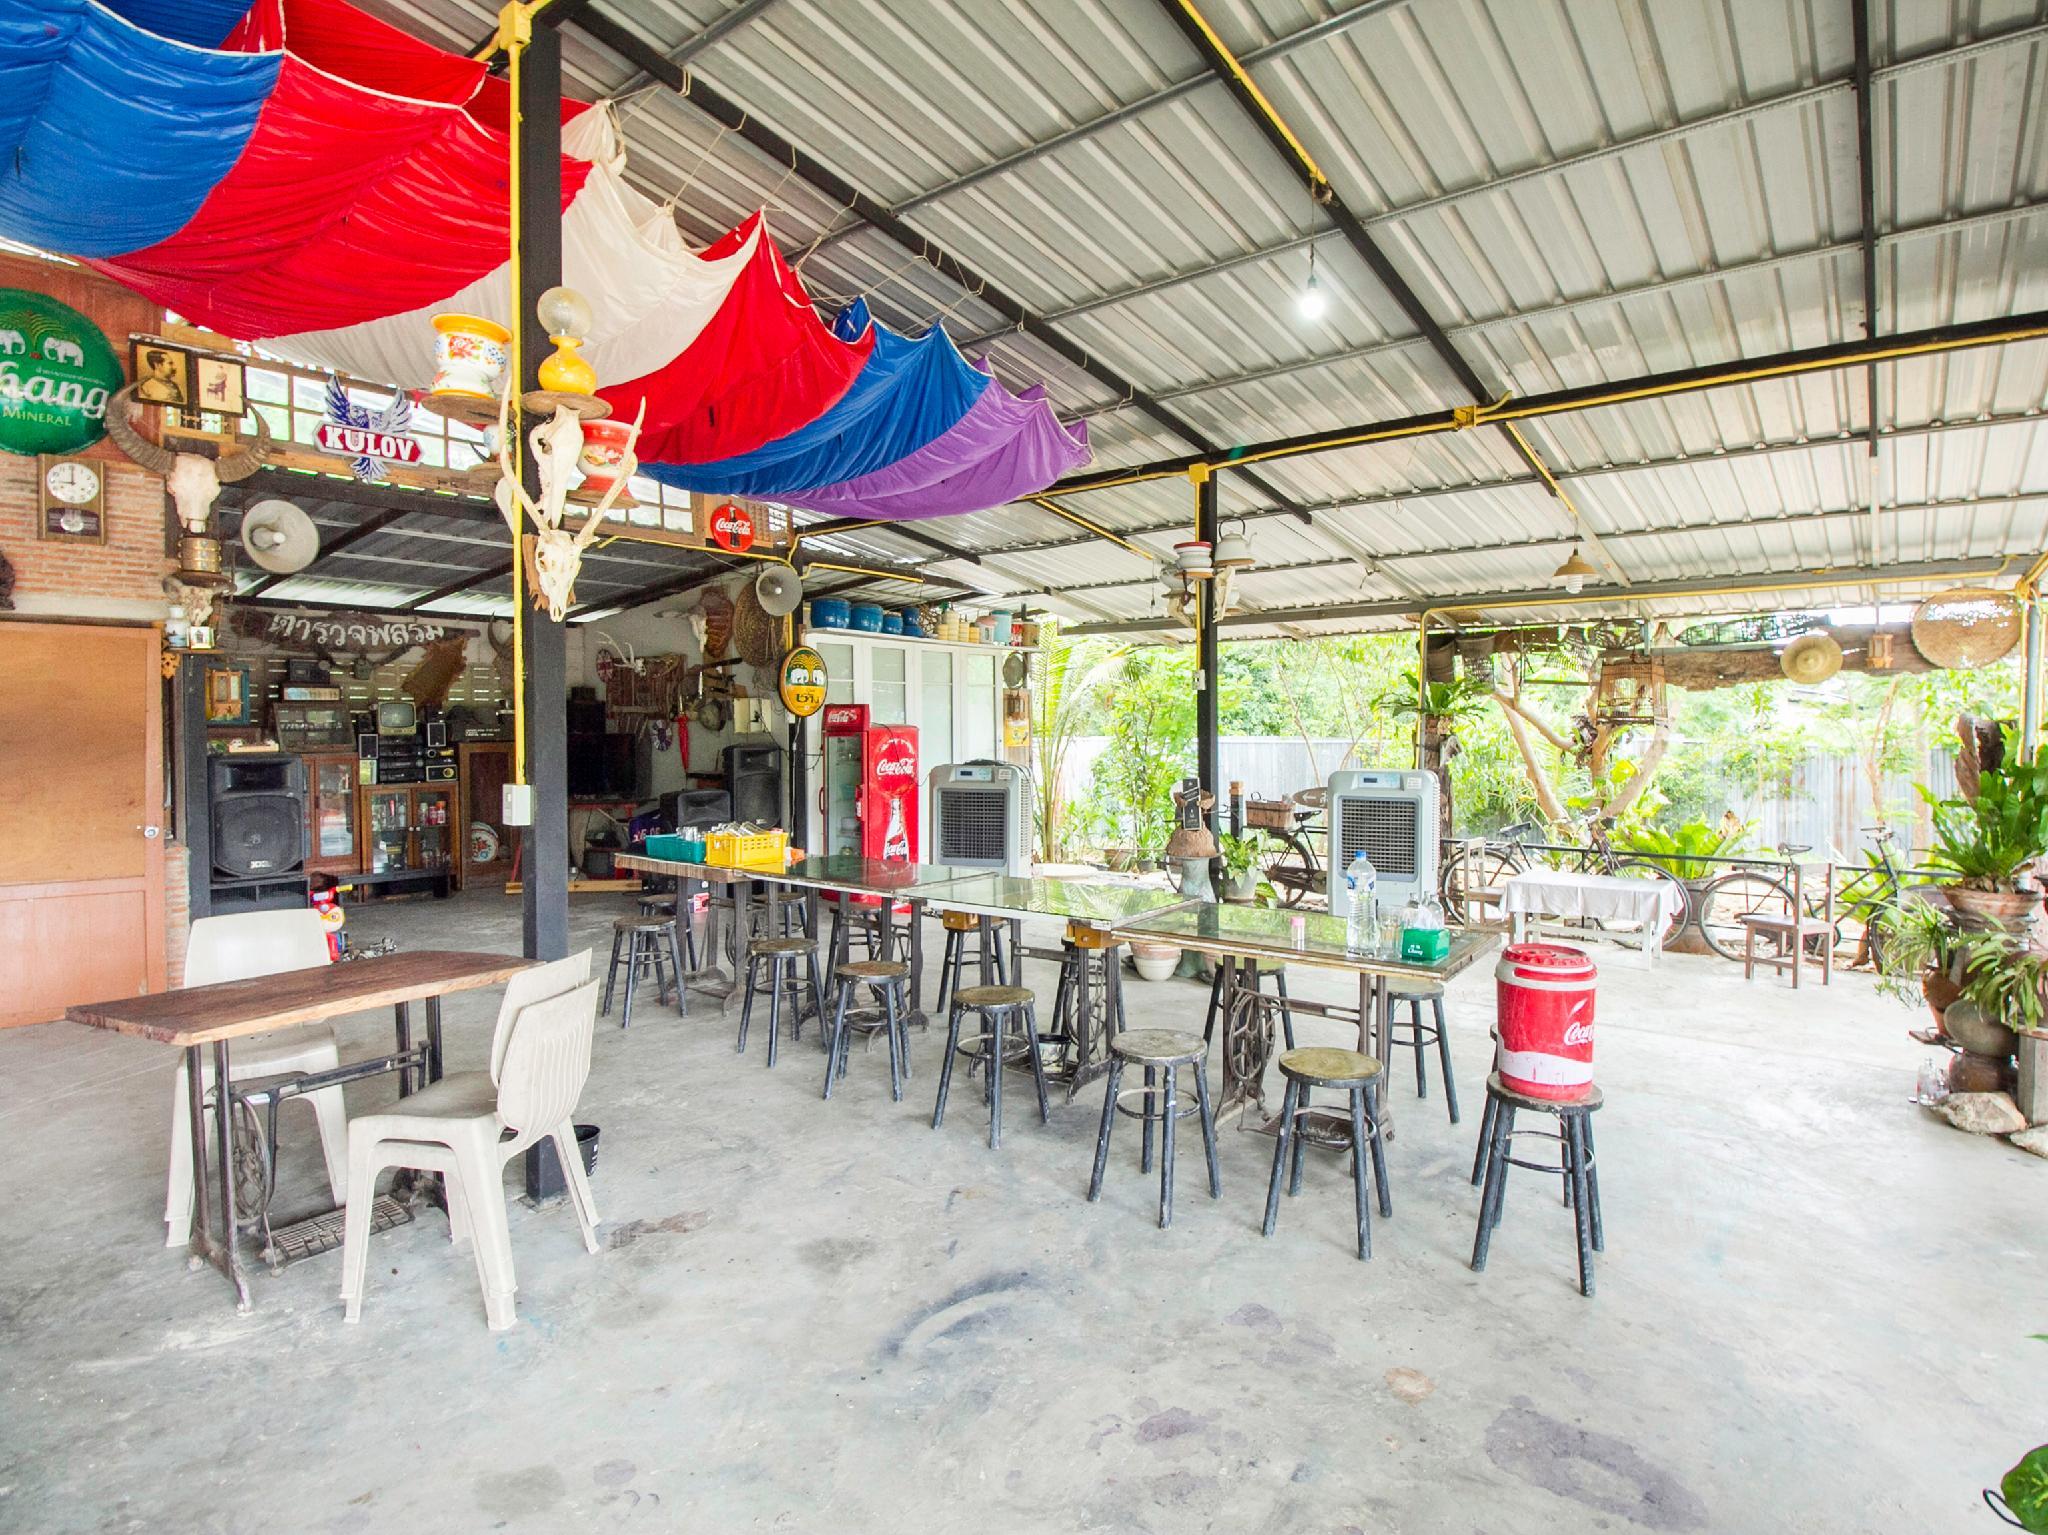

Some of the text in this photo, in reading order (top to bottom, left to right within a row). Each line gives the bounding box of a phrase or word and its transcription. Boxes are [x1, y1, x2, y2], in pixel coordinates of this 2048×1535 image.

[0, 361, 109, 419] hang
[3, 404, 72, 427] MINERAL
[325, 425, 414, 461] KULOV
